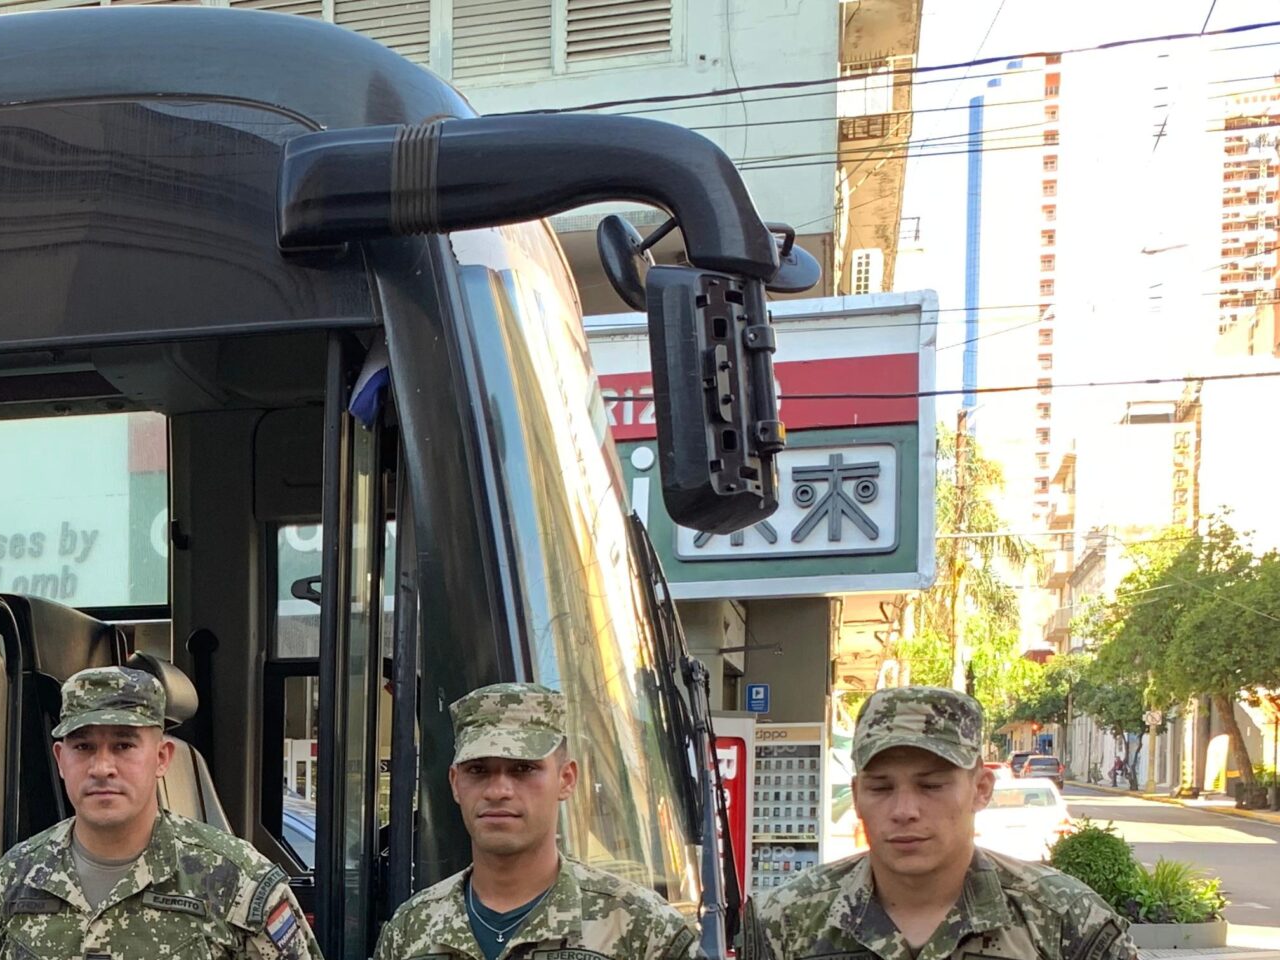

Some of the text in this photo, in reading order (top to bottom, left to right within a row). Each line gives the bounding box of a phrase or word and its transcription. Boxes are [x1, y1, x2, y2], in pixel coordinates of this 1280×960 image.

[58, 521, 99, 563] by
[153, 895, 199, 911] EJERCITO
[251, 869, 283, 918] TRANSPORTE
